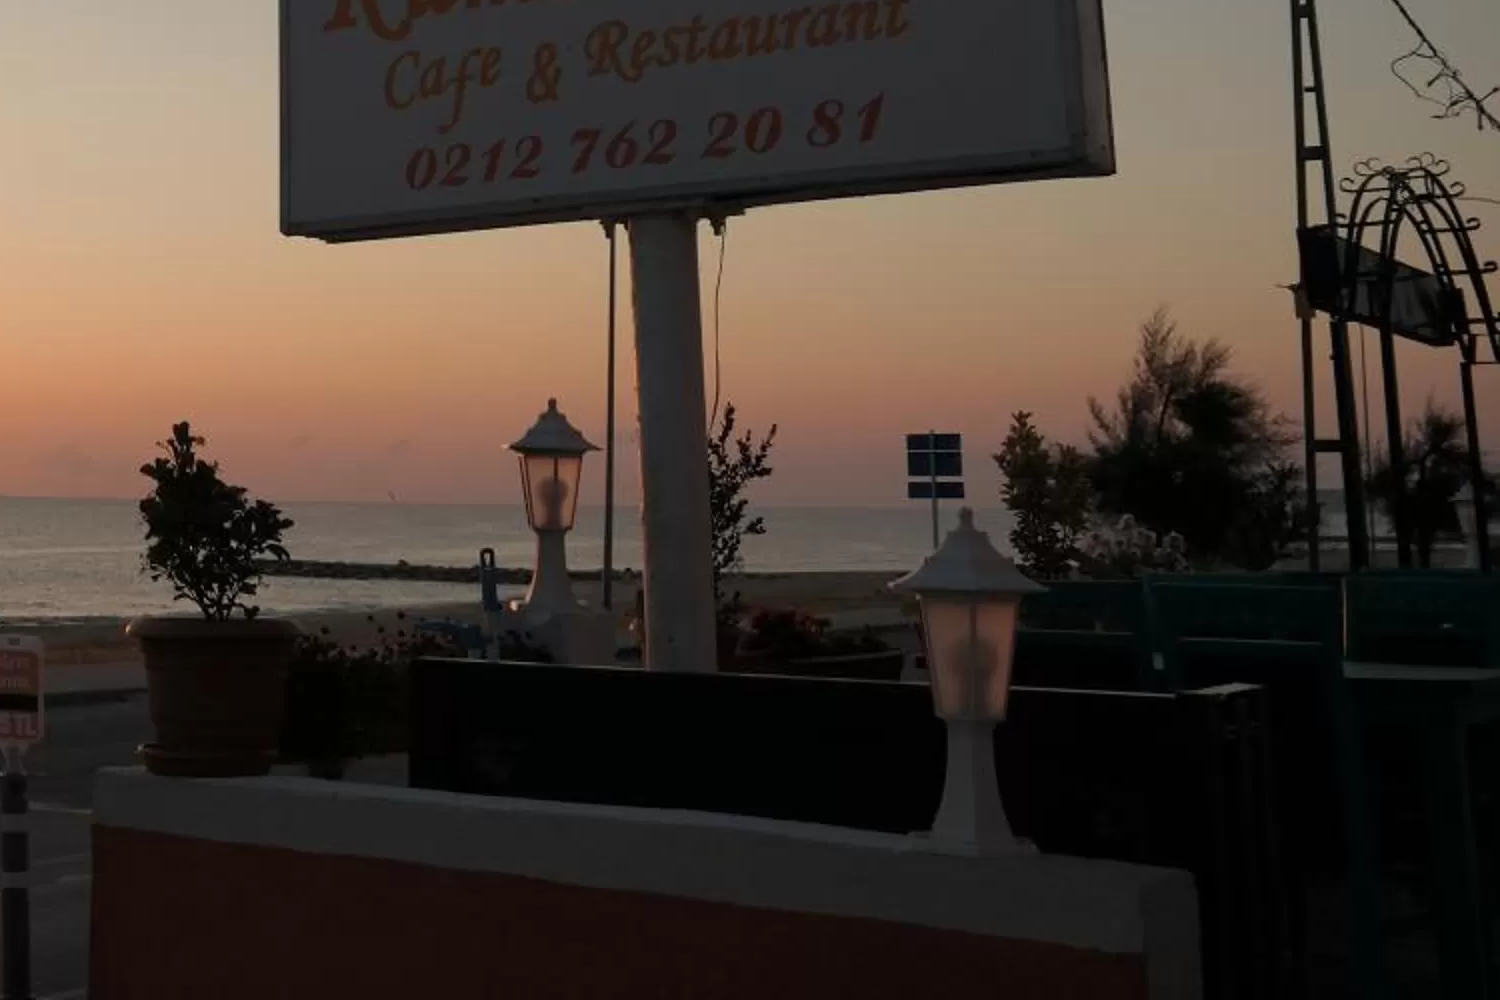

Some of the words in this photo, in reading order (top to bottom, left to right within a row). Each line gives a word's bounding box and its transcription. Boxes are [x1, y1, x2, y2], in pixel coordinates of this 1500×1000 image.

[383, 46, 502, 134] Cafe
[526, 43, 561, 104] &
[404, 134, 543, 191] 0212
[570, 118, 679, 173] 762
[702, 104, 783, 159] 20
[806, 92, 887, 148] 81
